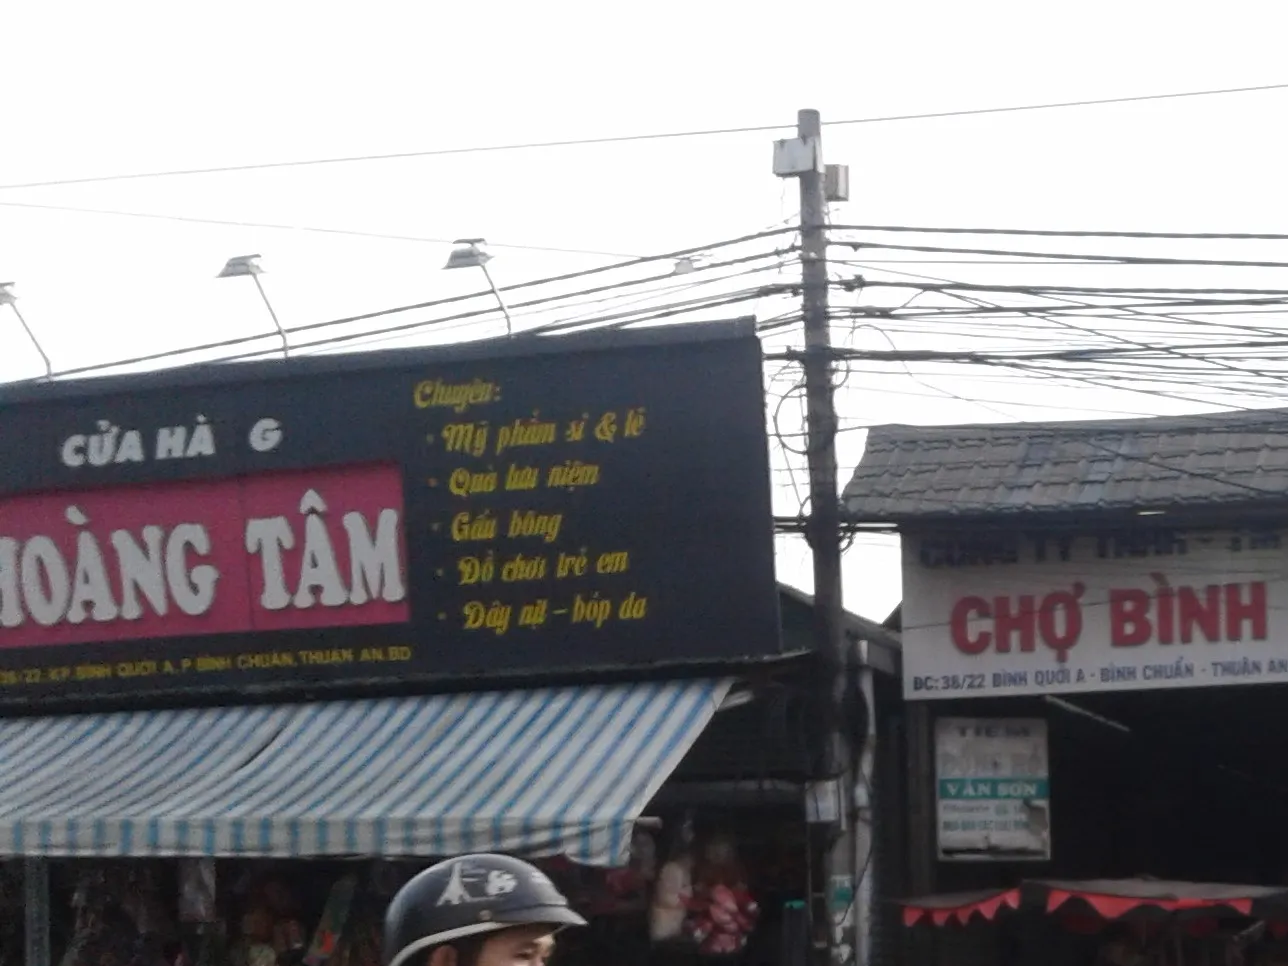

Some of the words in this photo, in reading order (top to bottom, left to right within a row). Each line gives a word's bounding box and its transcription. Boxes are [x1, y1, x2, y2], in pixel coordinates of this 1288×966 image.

[61, 419, 145, 468] CỬA
[245, 487, 406, 611] TÂM
[951, 581, 1086, 664] CHỢ
[1109, 571, 1268, 648] BÌNH
